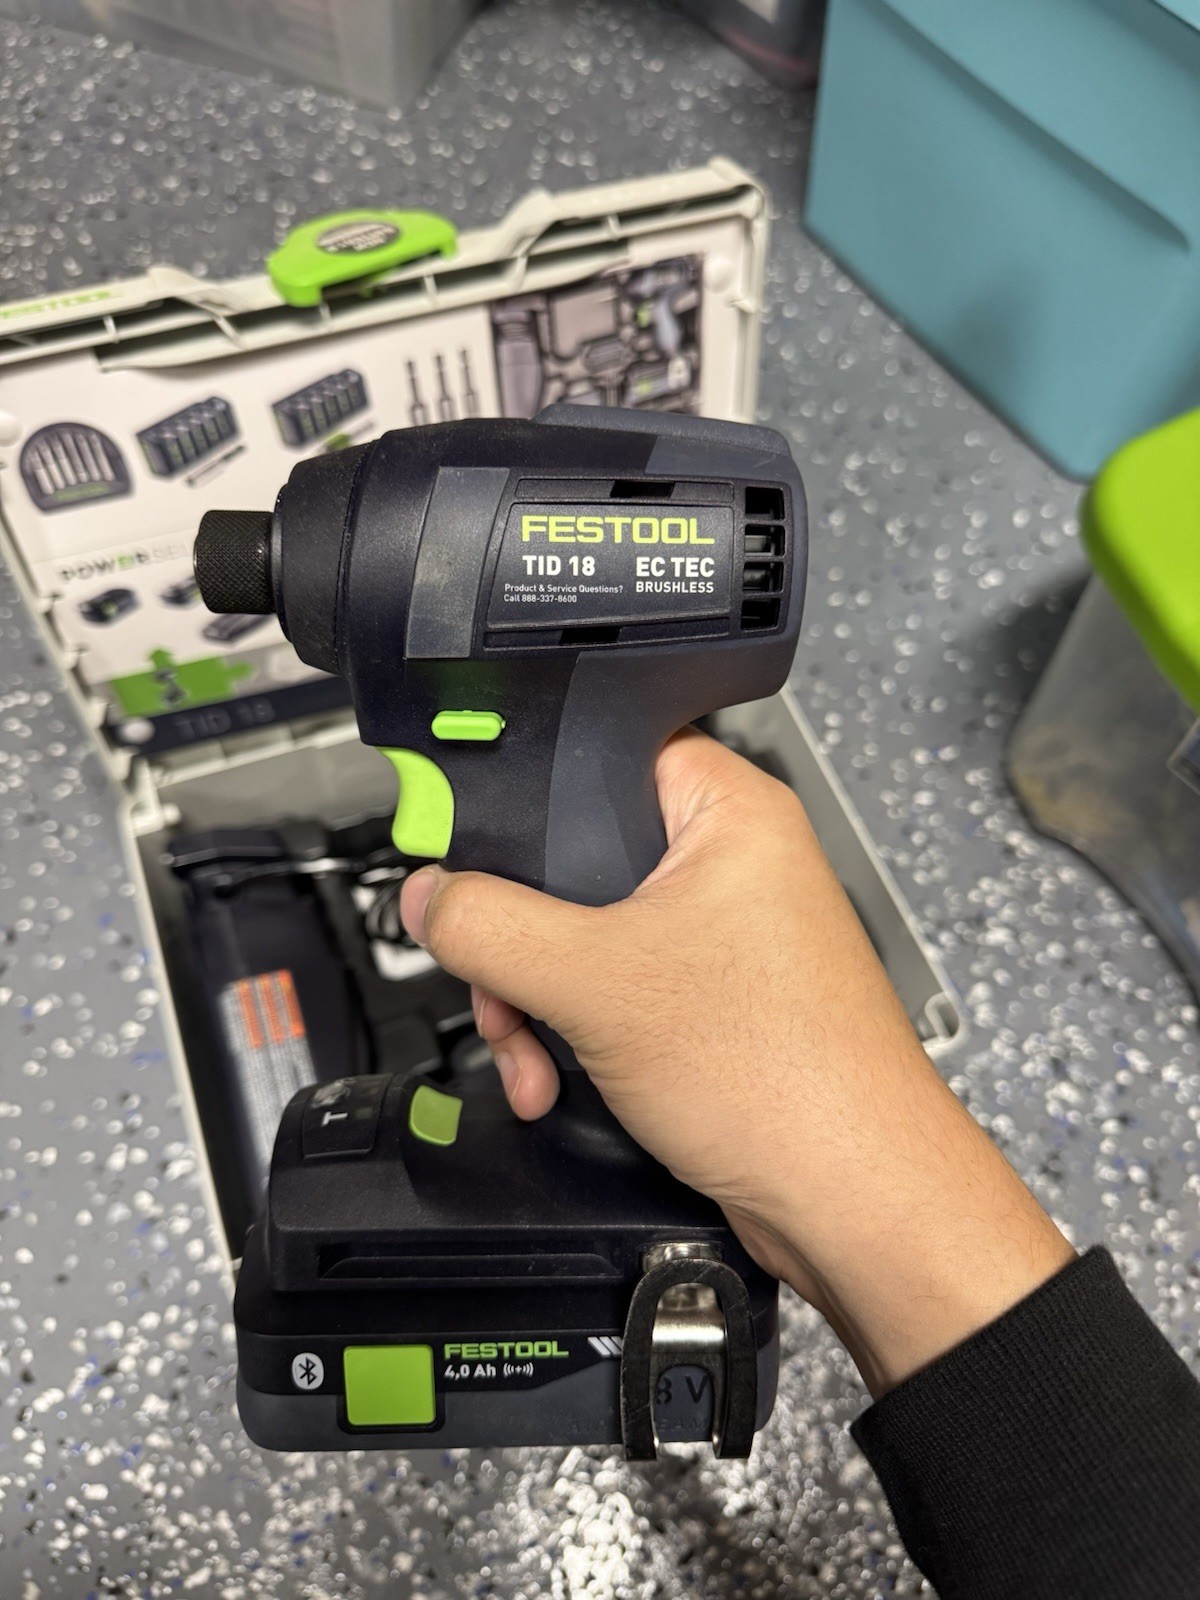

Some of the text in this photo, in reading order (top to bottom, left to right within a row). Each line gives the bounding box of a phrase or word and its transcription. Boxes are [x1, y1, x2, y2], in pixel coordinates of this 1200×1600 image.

[521, 515, 715, 545] FESTOOL
[522, 555, 595, 577] TID 18
[636, 556, 715, 578] EC TEC
[504, 584, 624, 594] Product & Service Questions?
[635, 581, 715, 594] BRUSHLESS
[504, 594, 577, 603] Call 888-337-8600
[444, 1340, 569, 1360] FESTOOL
[444, 1363, 496, 1381] 4,0 Ah
[685, 1375, 709, 1403] V
